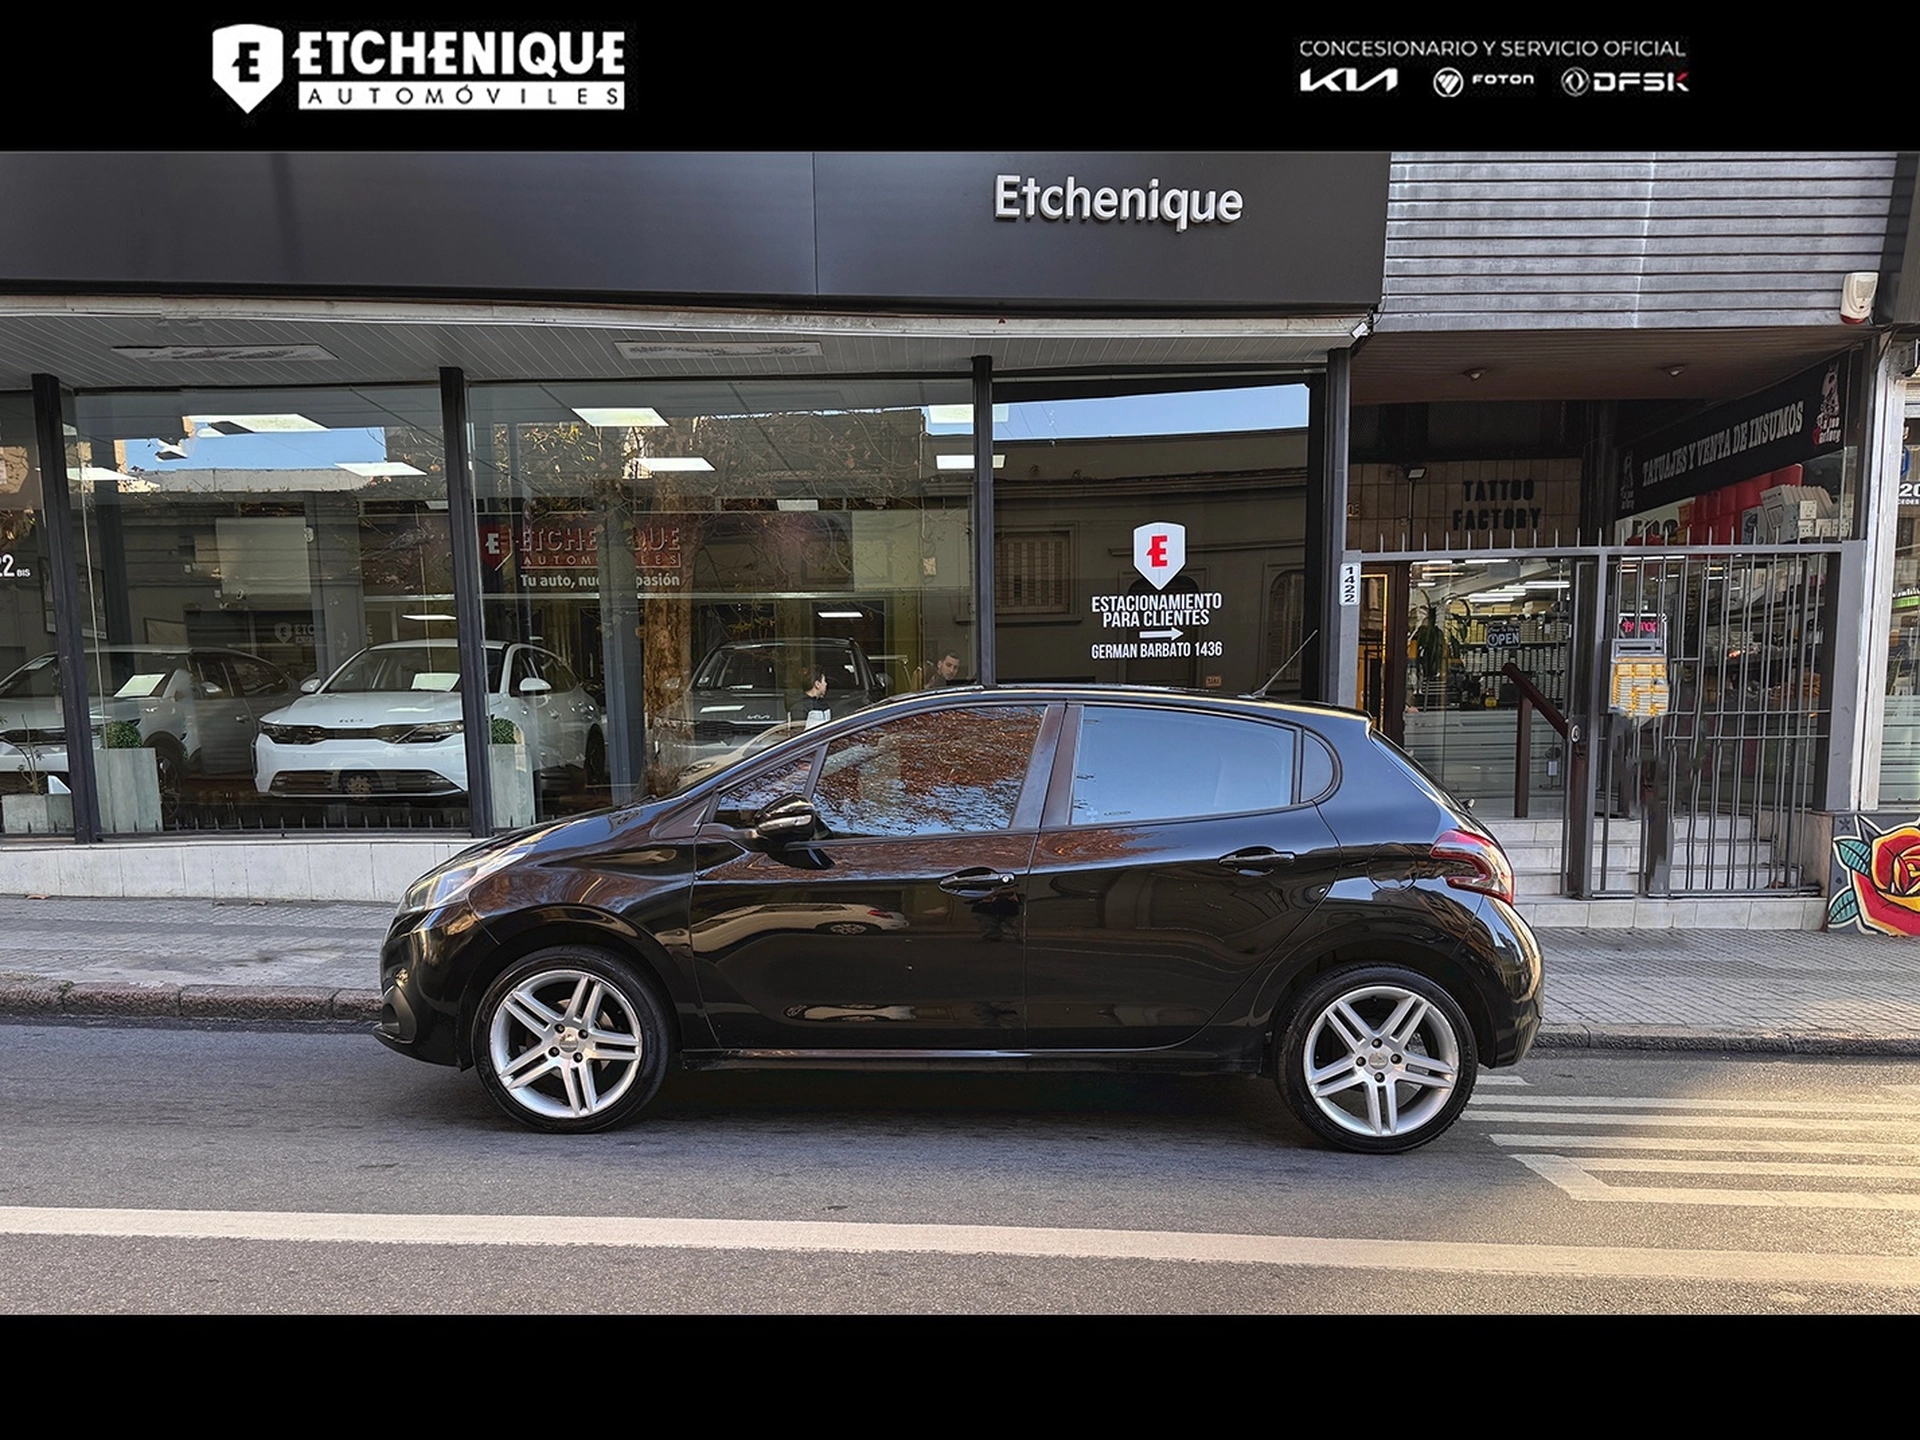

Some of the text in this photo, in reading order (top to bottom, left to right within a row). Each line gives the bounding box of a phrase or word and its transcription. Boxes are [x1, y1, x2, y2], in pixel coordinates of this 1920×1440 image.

[995, 175, 1243, 232] Etchenique
[1642, 401, 1804, 487] TATUAJES Y VENTA DE INSUMOS
[1463, 479, 1536, 501] TATTOO
[1453, 507, 1542, 531] FACTORY
[520, 574, 537, 587] Tu
[539, 574, 575, 589] auto,
[635, 573, 681, 590] pasión
[1344, 566, 1356, 603] 1422
[1091, 592, 1222, 612] ESTACIONAMIENTO
[1103, 609, 1210, 628] PARA CLIENTES
[1091, 641, 1223, 659] GERMAN BARBATO 1436
[1487, 632, 1520, 647] OPEN
